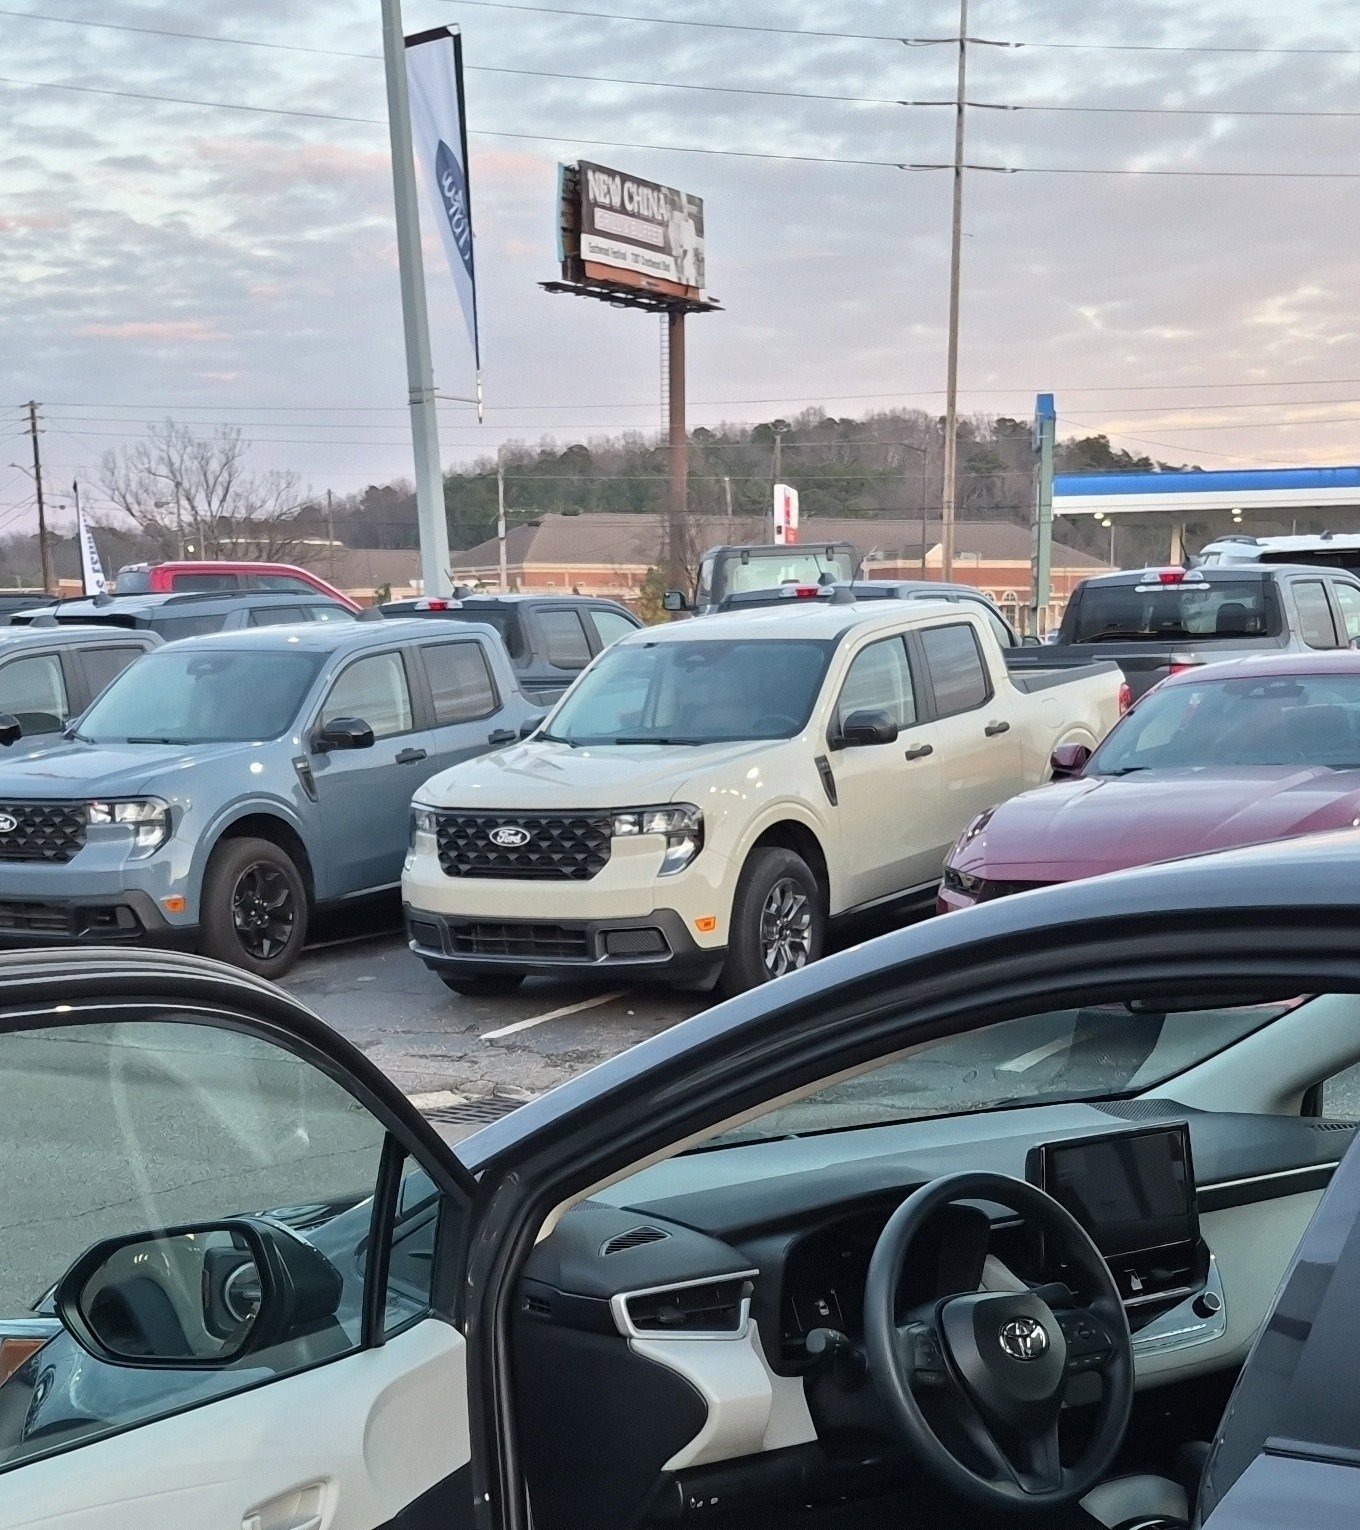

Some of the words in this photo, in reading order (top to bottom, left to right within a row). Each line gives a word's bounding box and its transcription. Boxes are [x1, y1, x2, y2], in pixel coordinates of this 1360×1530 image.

[587, 169, 622, 210] NEW
[623, 181, 670, 222] CHINA
[494, 828, 525, 845] Ford
